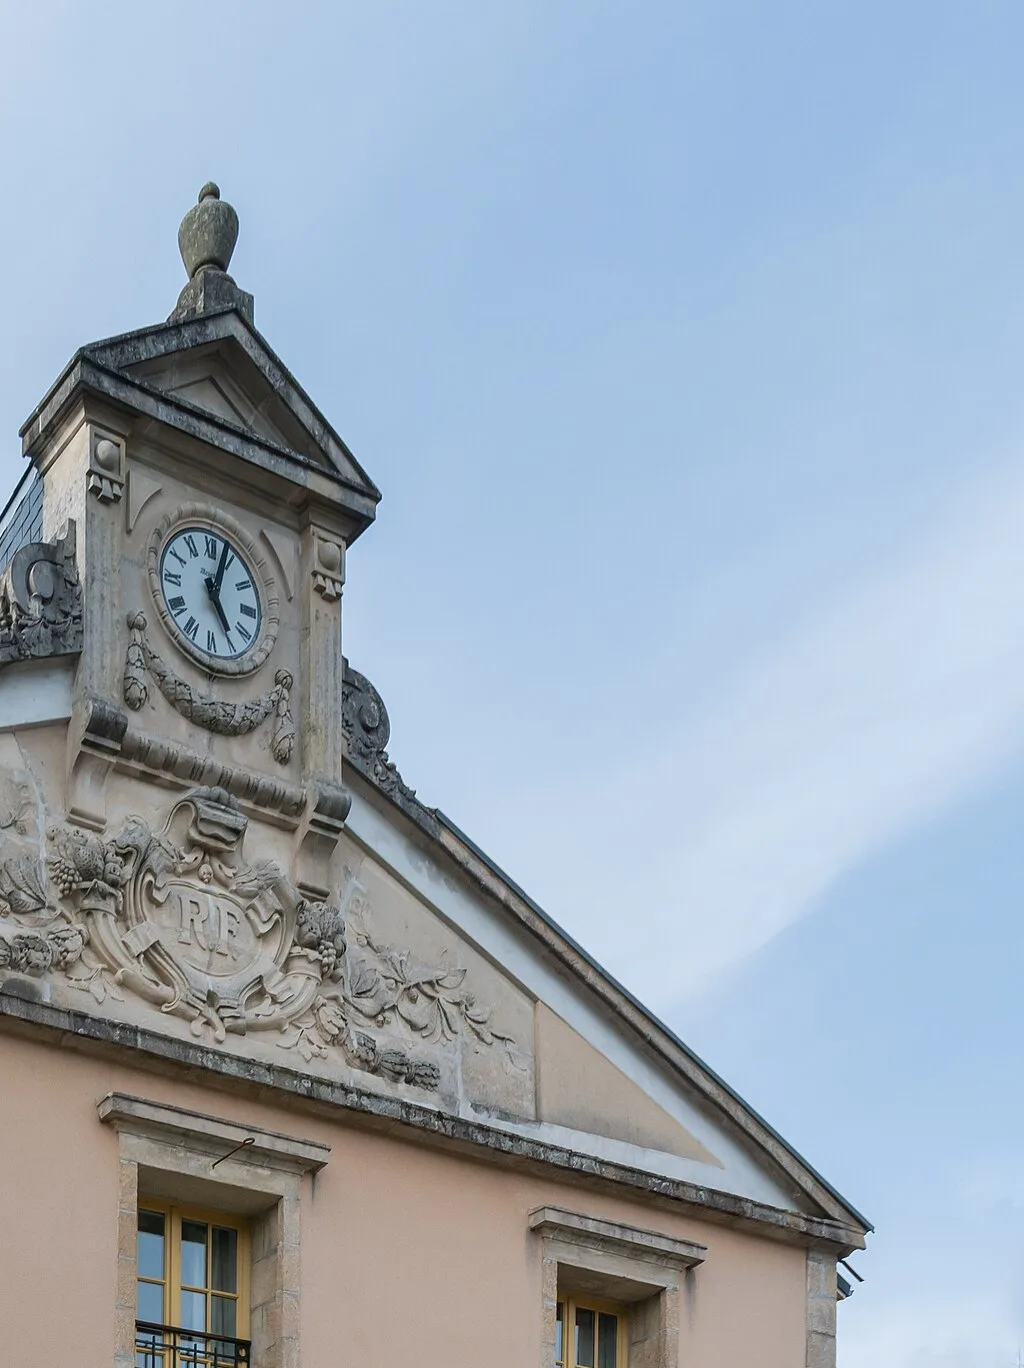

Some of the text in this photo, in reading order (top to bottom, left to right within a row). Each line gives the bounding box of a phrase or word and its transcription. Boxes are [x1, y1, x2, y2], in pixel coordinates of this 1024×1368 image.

[169, 546, 187, 568] X
[183, 535, 199, 558] XI
[204, 536, 217, 560] XII
[164, 568, 181, 587] IX
[235, 580, 252, 591] II
[183, 616, 199, 641] VII
[207, 630, 217, 653] VI
